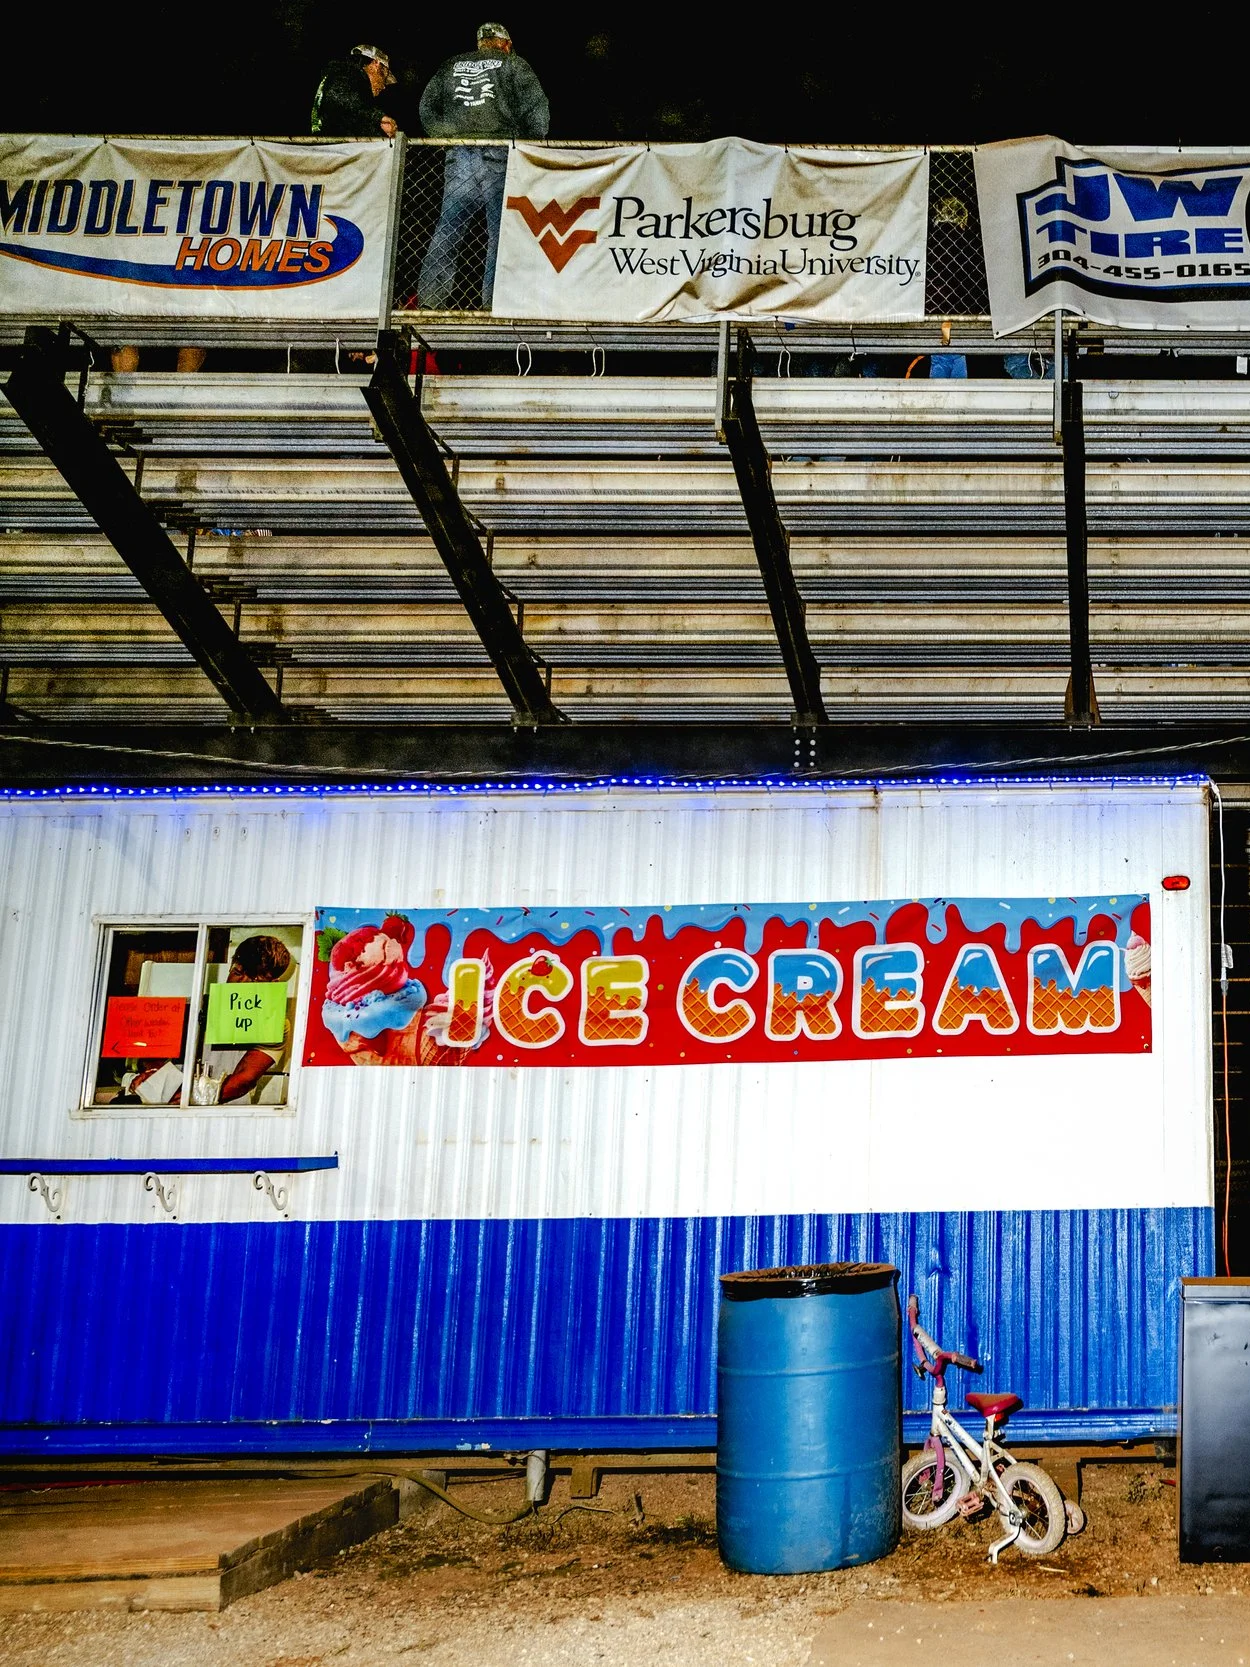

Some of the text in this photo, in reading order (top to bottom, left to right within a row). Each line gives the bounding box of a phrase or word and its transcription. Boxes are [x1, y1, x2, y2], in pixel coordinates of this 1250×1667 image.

[0, 179, 325, 239] MIDDLETOWN
[1035, 173, 1244, 222] JW
[608, 196, 862, 251] Parkersburg
[1036, 220, 1244, 258] TIRE
[175, 237, 335, 273] HOMES
[609, 247, 680, 275] West
[679, 248, 781, 278] Virginia
[230, 992, 262, 1010] Pick
[441, 940, 1123, 1049] ICE CREAM
[235, 1017, 253, 1032] up
